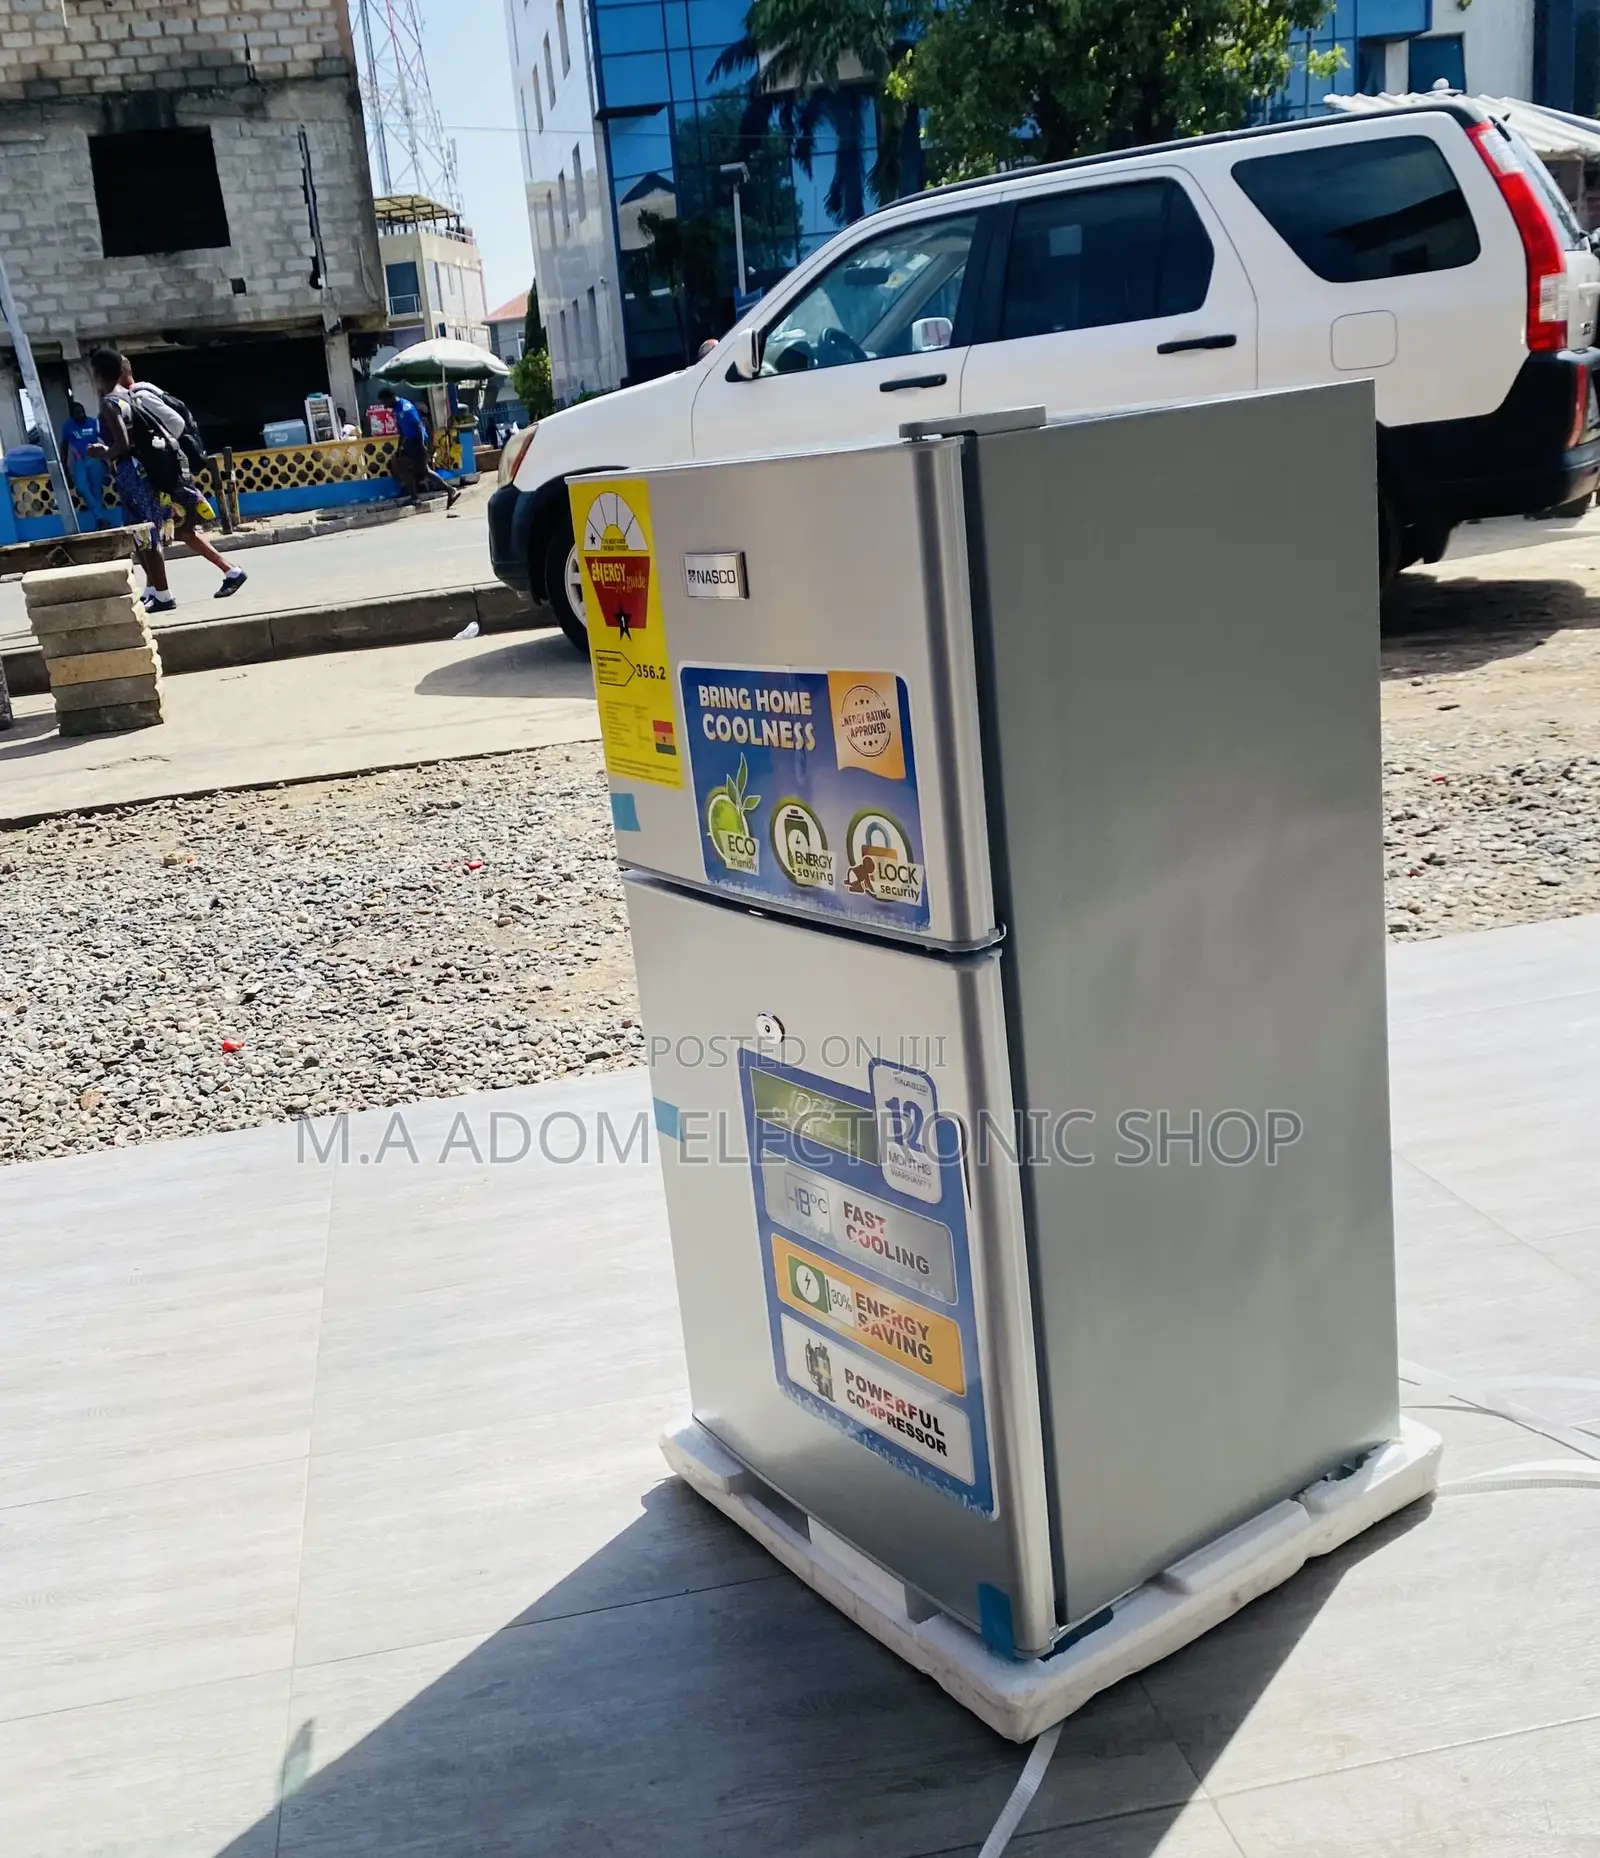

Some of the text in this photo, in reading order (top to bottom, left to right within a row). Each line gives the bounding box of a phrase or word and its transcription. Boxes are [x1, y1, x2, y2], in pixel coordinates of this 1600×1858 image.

[696, 569, 737, 584] NASCO
[636, 663, 666, 680] 356.2
[698, 685, 813, 716] BRING HOME
[866, 708, 891, 722] RATING
[702, 713, 816, 752] COOLNESS
[850, 722, 887, 739] APPROVED
[728, 834, 757, 855] ECO
[729, 855, 759, 873] friendly
[794, 850, 834, 869] ENERGY
[796, 867, 835, 885] saving
[877, 863, 919, 887] LOCK
[880, 883, 922, 903] security
[884, 1096, 929, 1155] 12
[887, 1150, 932, 1176] MONTHS
[843, 1200, 888, 1235] FAST
[846, 1223, 931, 1276] COOLING
[830, 1289, 854, 1314] 30%
[855, 1291, 930, 1342] ENERGY
[856, 1312, 934, 1366] SAVING
[844, 1367, 946, 1438] POWERFUL
[846, 1388, 949, 1457] COMPRESSOR
